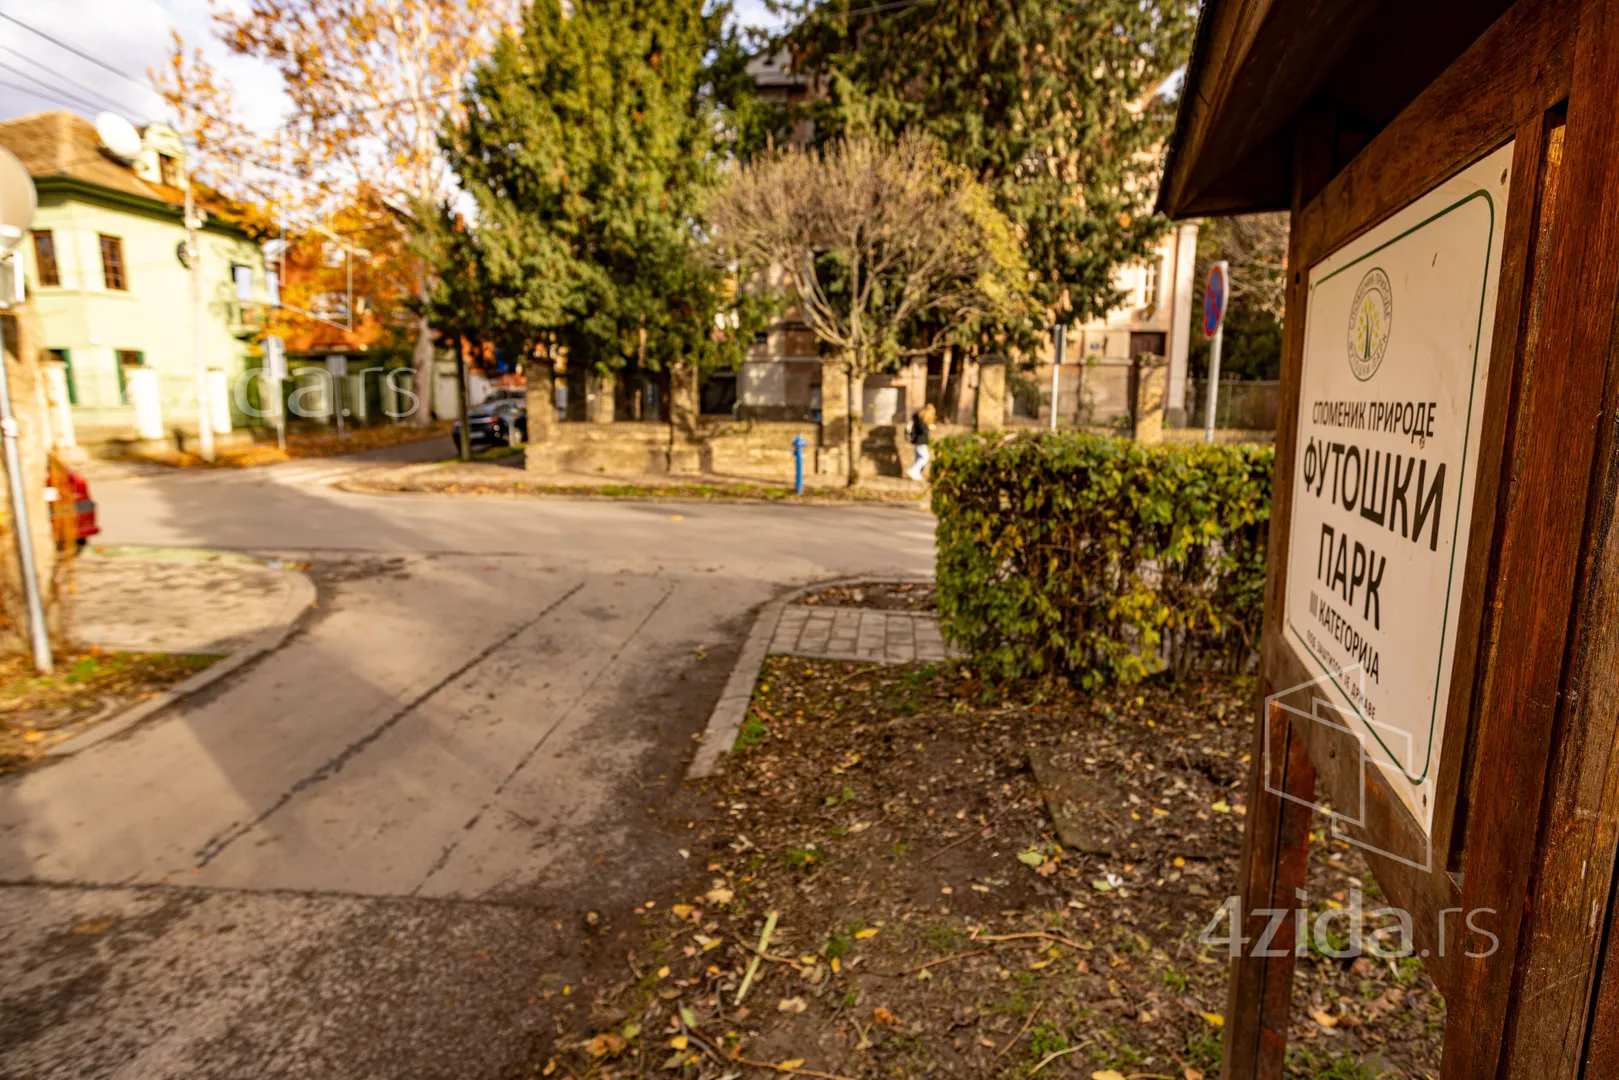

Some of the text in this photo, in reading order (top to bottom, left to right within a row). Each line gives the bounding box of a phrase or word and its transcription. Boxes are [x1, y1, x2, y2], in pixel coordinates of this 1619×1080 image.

[1312, 400, 1437, 444] СПОМЕНИК ПРИРОДЕ
[1303, 436, 1447, 552] ФУТОШКИ
[1317, 522, 1387, 631] ПАРК
[1318, 598, 1379, 685] КАТЕГОРИЈА
